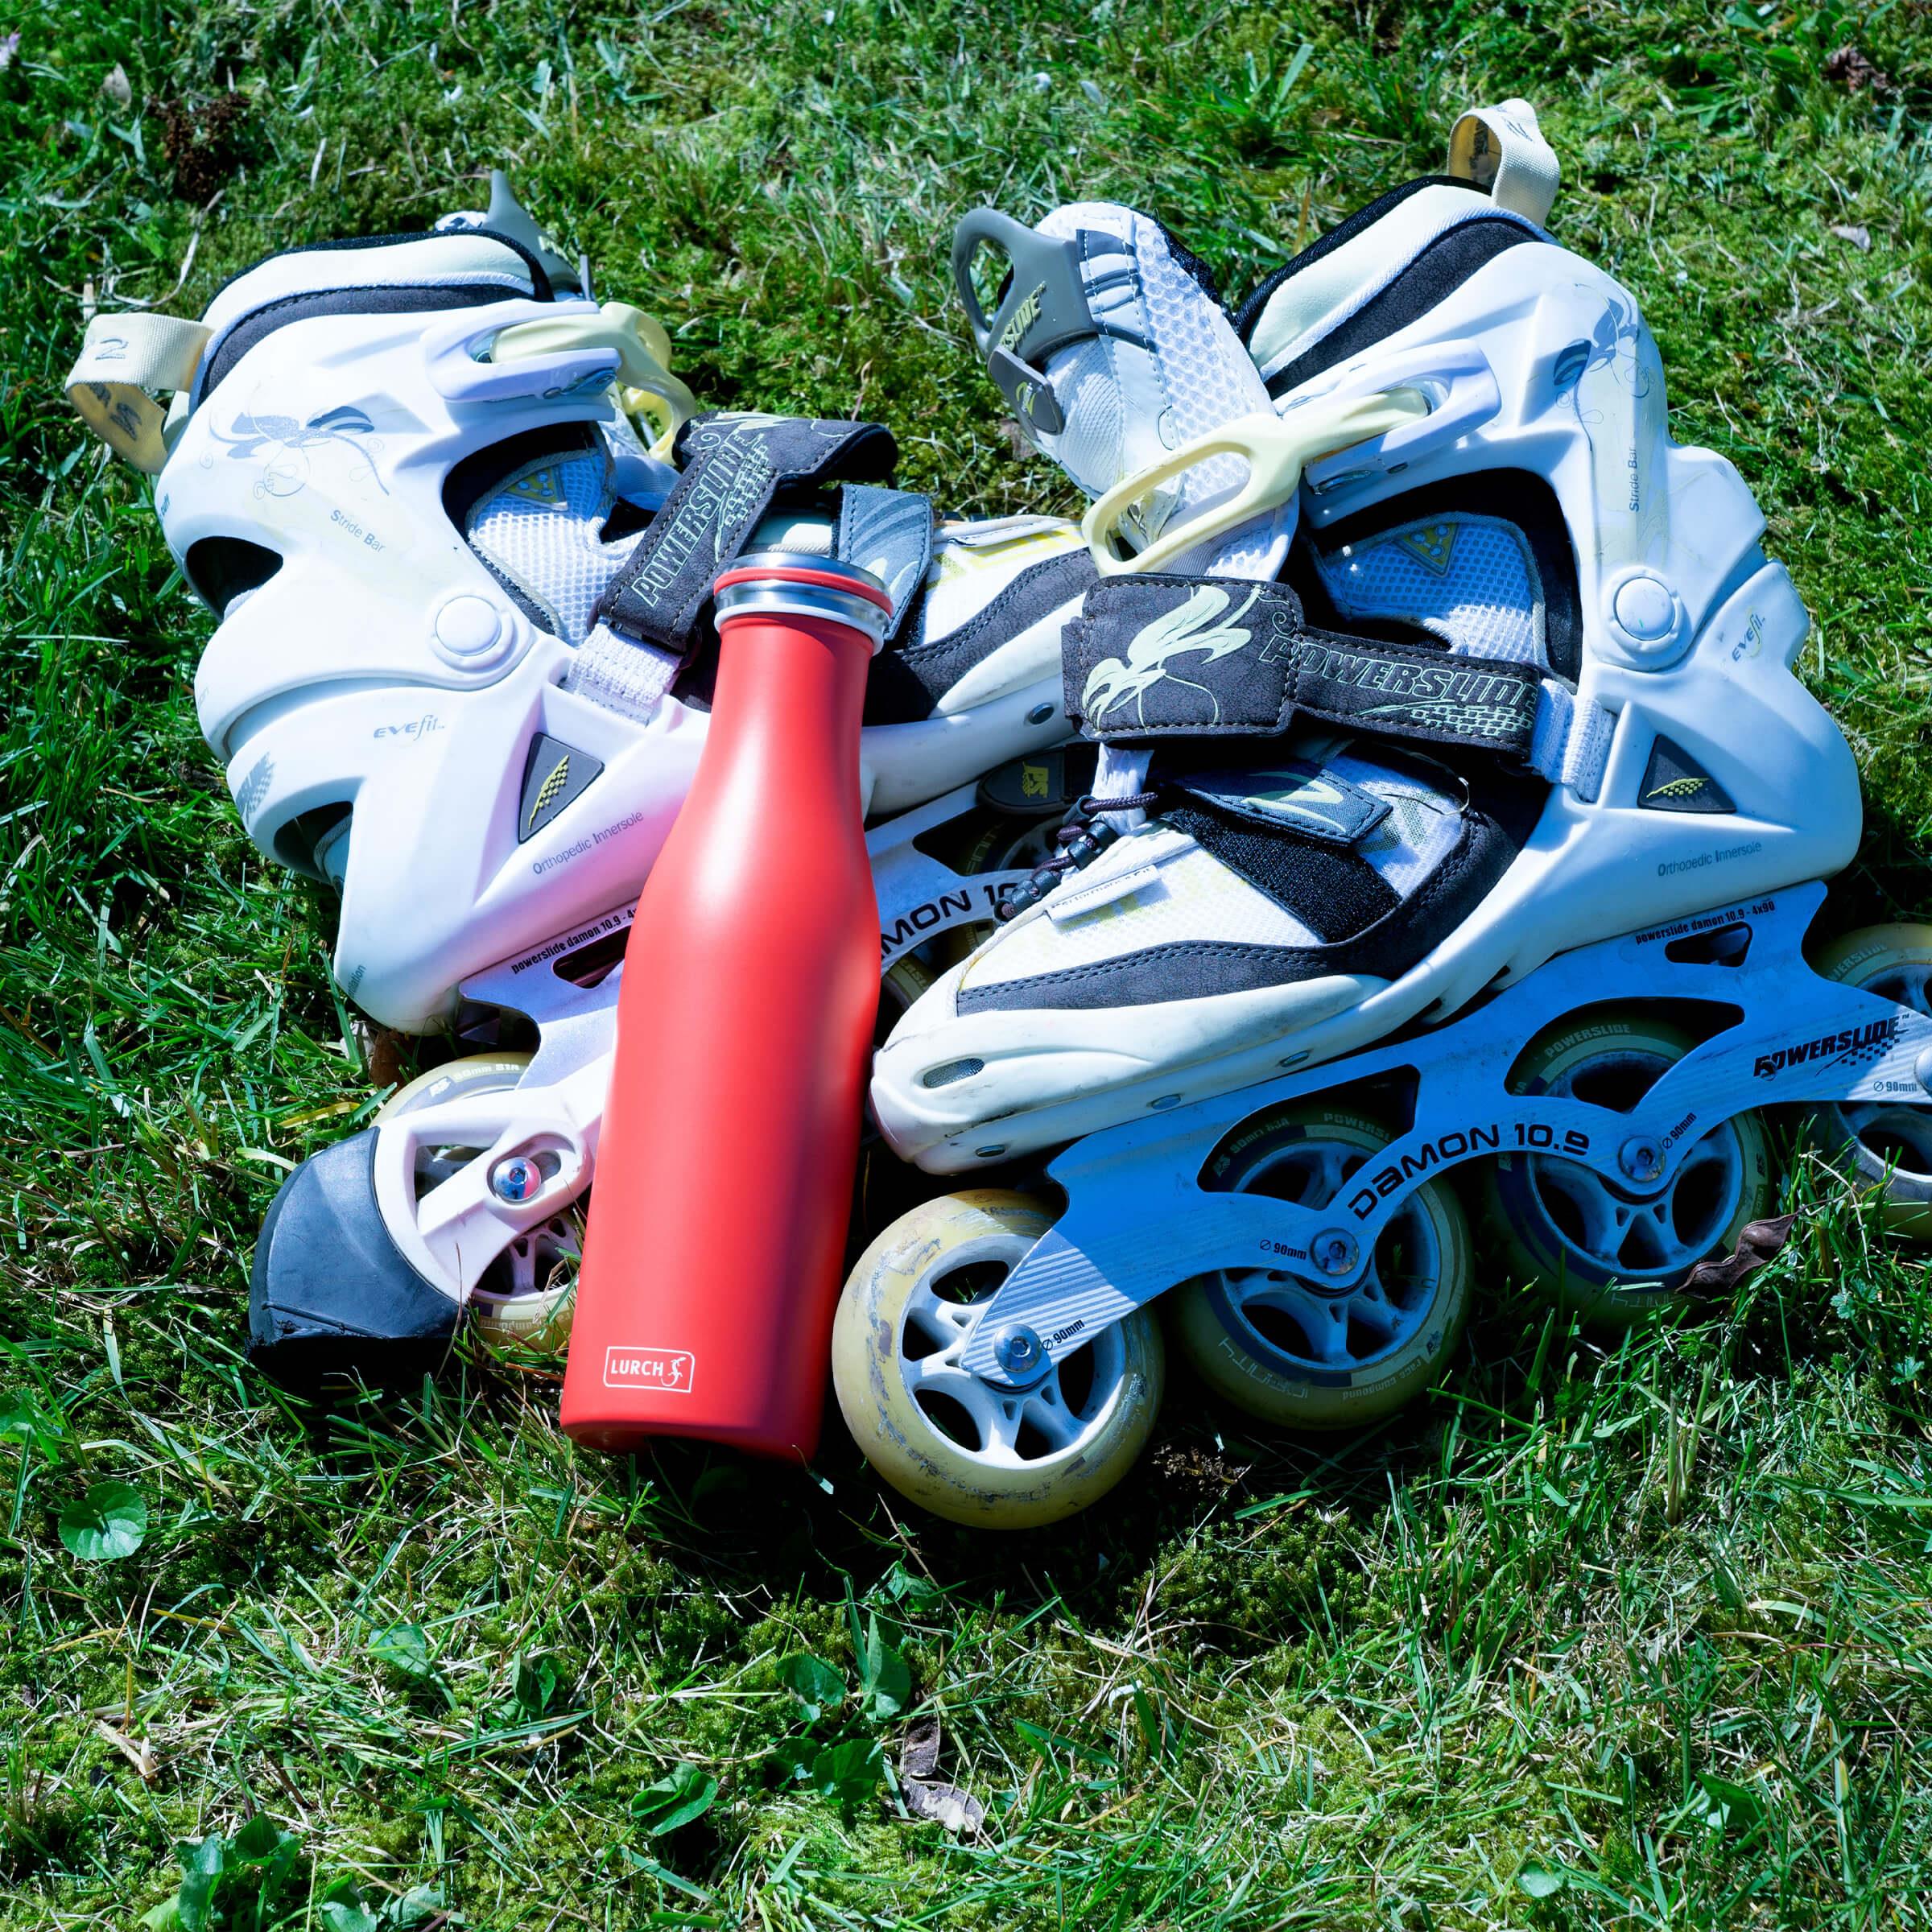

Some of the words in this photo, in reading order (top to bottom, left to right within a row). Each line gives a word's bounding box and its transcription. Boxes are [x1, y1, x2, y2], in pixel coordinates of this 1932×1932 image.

[1628, 446, 1637, 469] Bar
[1629, 473, 1640, 512] Stride
[330, 510, 362, 538] Stride
[363, 533, 386, 552] Bar
[532, 838, 592, 875] Orthopedic
[592, 811, 644, 844] Innersole
[1657, 853, 1713, 877] Orthopedic
[1715, 841, 1762, 862] Innersole
[881, 890, 972, 956] MON
[1635, 923, 1690, 945] powerslide
[1691, 914, 1725, 931] damon
[1725, 908, 1745, 922] 10.9
[1752, 900, 1776, 915] 4x90
[510, 941, 567, 975] powerslide
[567, 926, 601, 948] damon
[601, 914, 621, 931] 10.9
[1543, 1024, 1631, 1058] POWERSLIDE
[1753, 1015, 1900, 1077] POWERSLIDE
[1886, 1081, 1918, 1092] 90mm
[1514, 1123, 1590, 1157] 10.9
[1670, 1112, 1697, 1140] 90mm
[1274, 1242, 1307, 1261] 90mm
[1053, 1319, 1085, 1344] 90mm
[610, 1359, 664, 1377] LURCH
